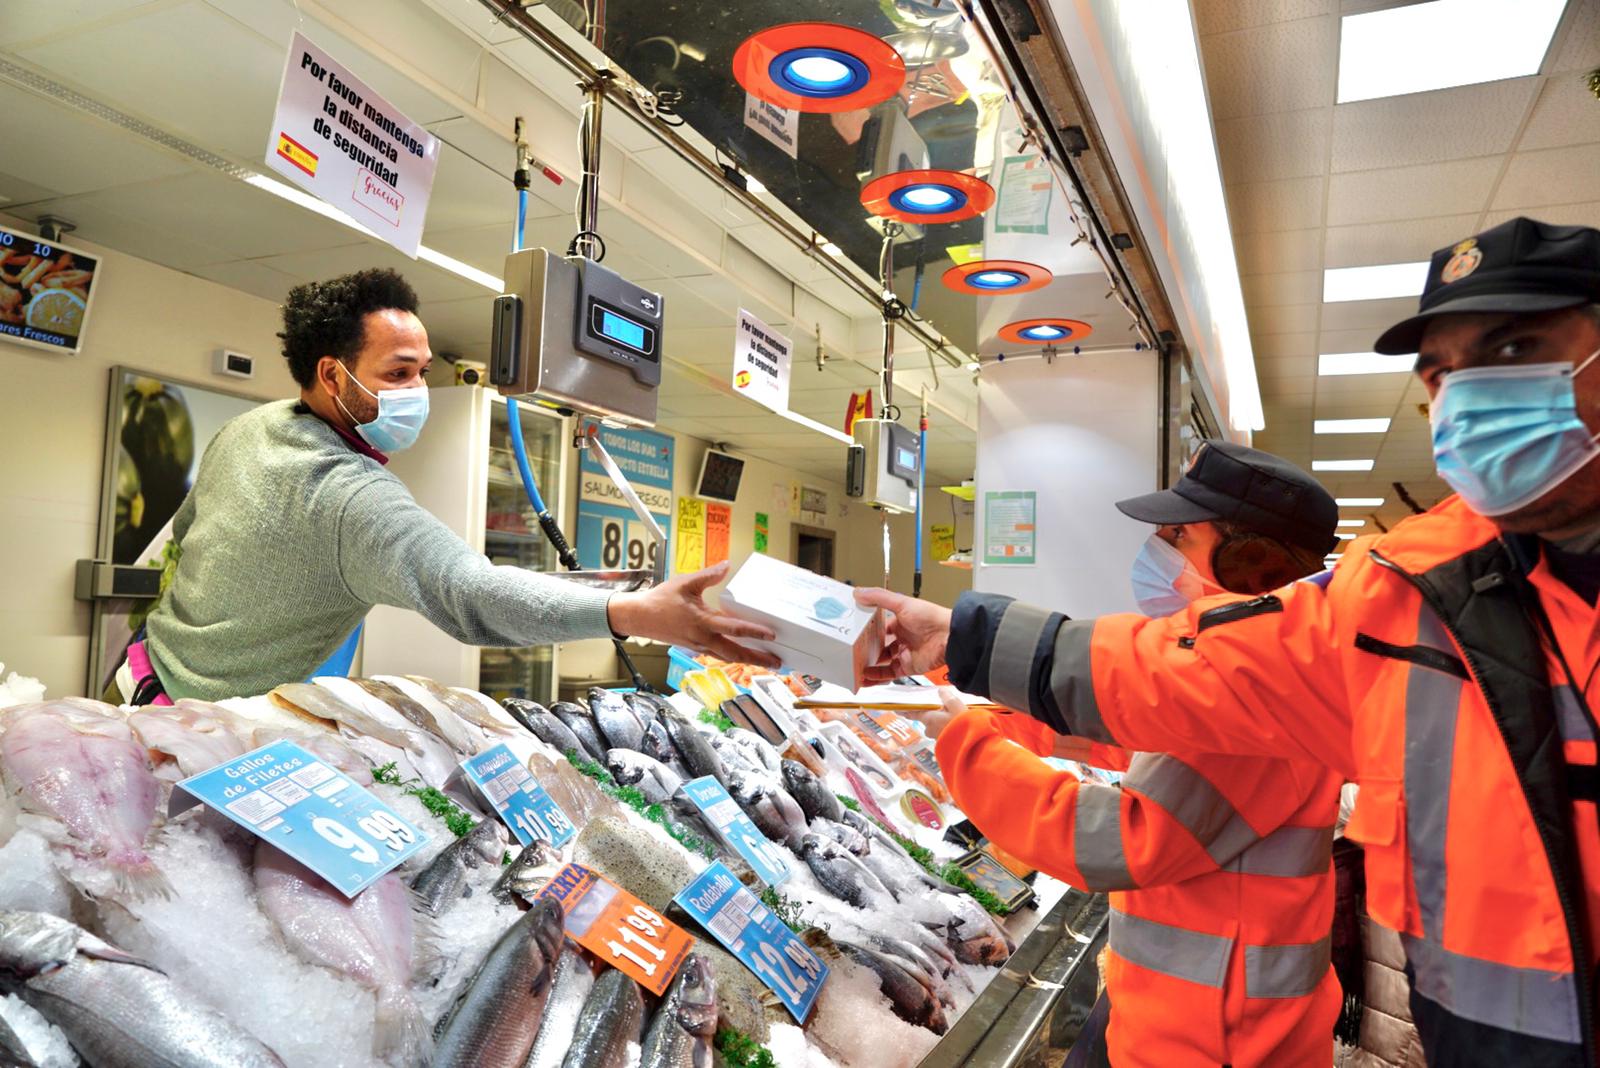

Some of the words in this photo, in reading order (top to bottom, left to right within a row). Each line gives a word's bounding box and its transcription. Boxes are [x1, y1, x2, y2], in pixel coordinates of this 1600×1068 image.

[301, 51, 327, 82] Por
[328, 72, 363, 110] favor
[363, 101, 425, 158] mantenga
[323, 95, 336, 118] la
[339, 109, 398, 163] distancia
[313, 117, 331, 141] de
[333, 131, 399, 187] seguridad
[364, 175, 400, 211] Gracias
[0, 231, 13, 246] O
[33, 243, 51, 257] 10
[0, 322, 20, 336] ares
[24, 327, 65, 345] Frescos
[741, 318, 751, 332] Por
[584, 480, 623, 499] SALMO
[636, 491, 669, 508] RESCO
[223, 752, 275, 780] Gallos
[223, 783, 247, 799] de
[248, 757, 304, 786] Filetes
[689, 872, 733, 914] Rodaballo
